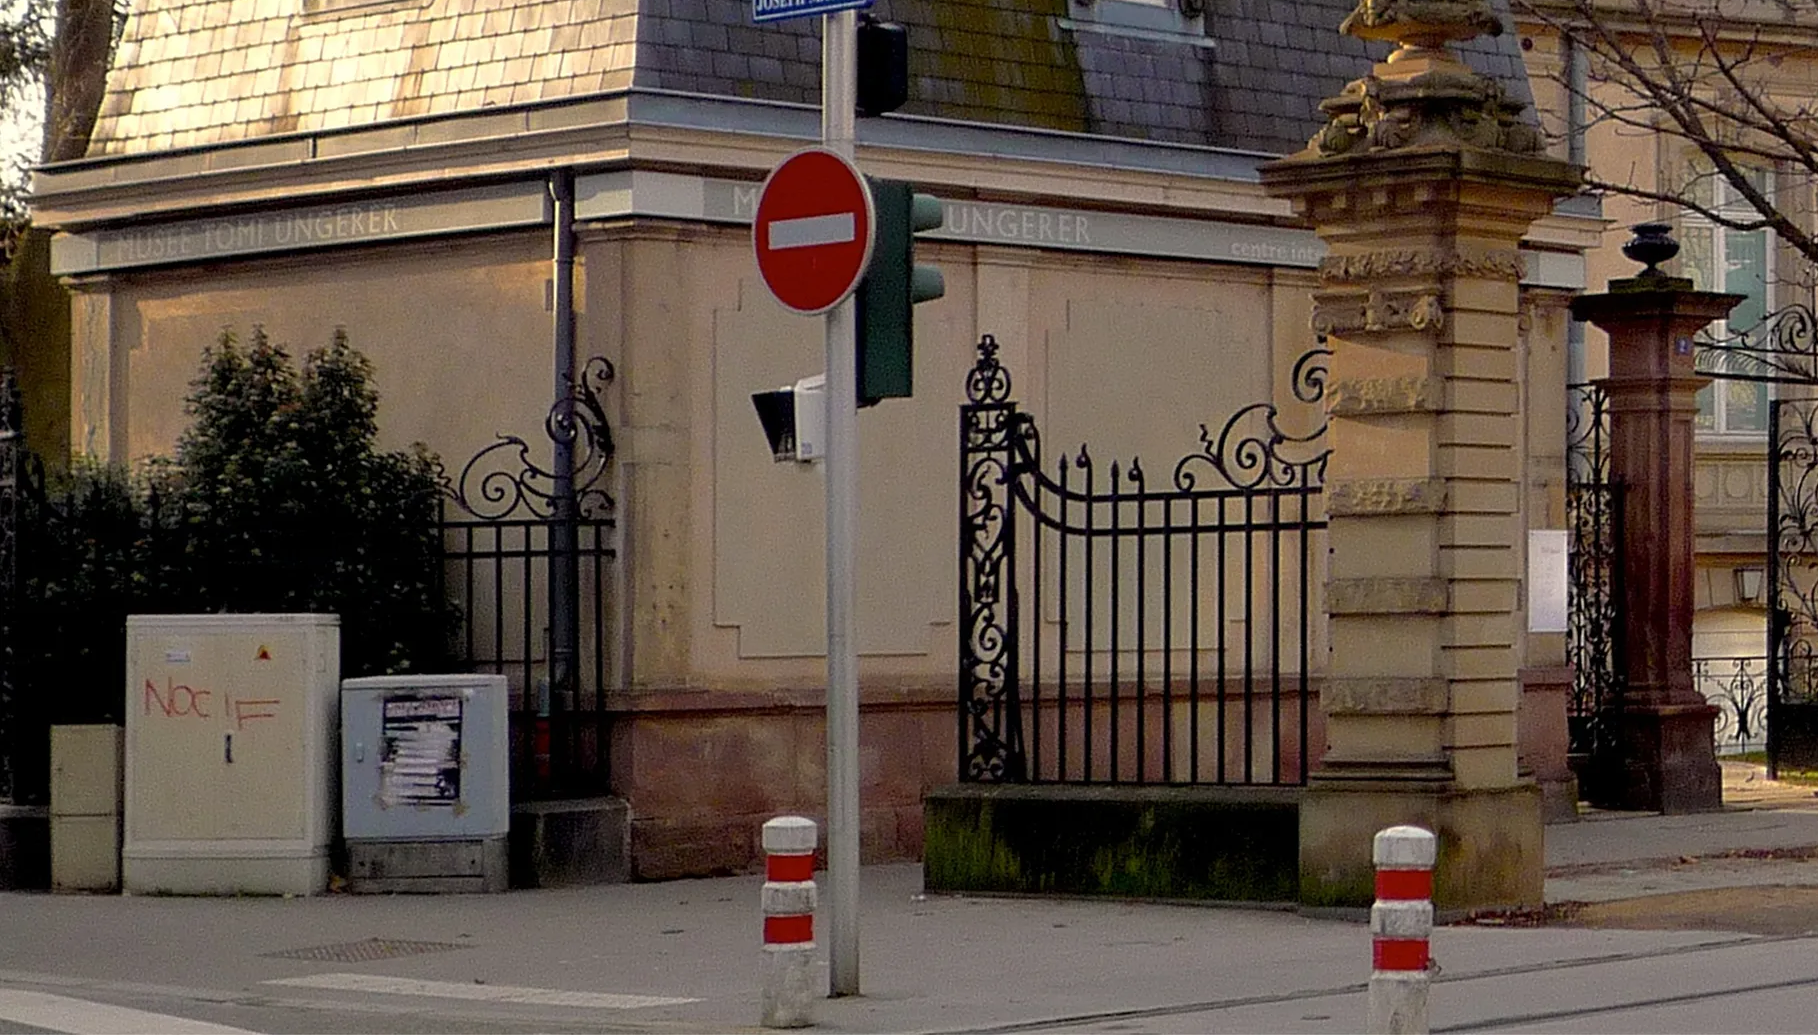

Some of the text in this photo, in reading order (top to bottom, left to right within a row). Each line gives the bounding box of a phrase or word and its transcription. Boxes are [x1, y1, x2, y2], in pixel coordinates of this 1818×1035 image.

[203, 219, 264, 250] TOMI
[275, 205, 400, 243] UNGERER
[949, 205, 1090, 243] UNGERER
[1230, 242, 1287, 262] centre
